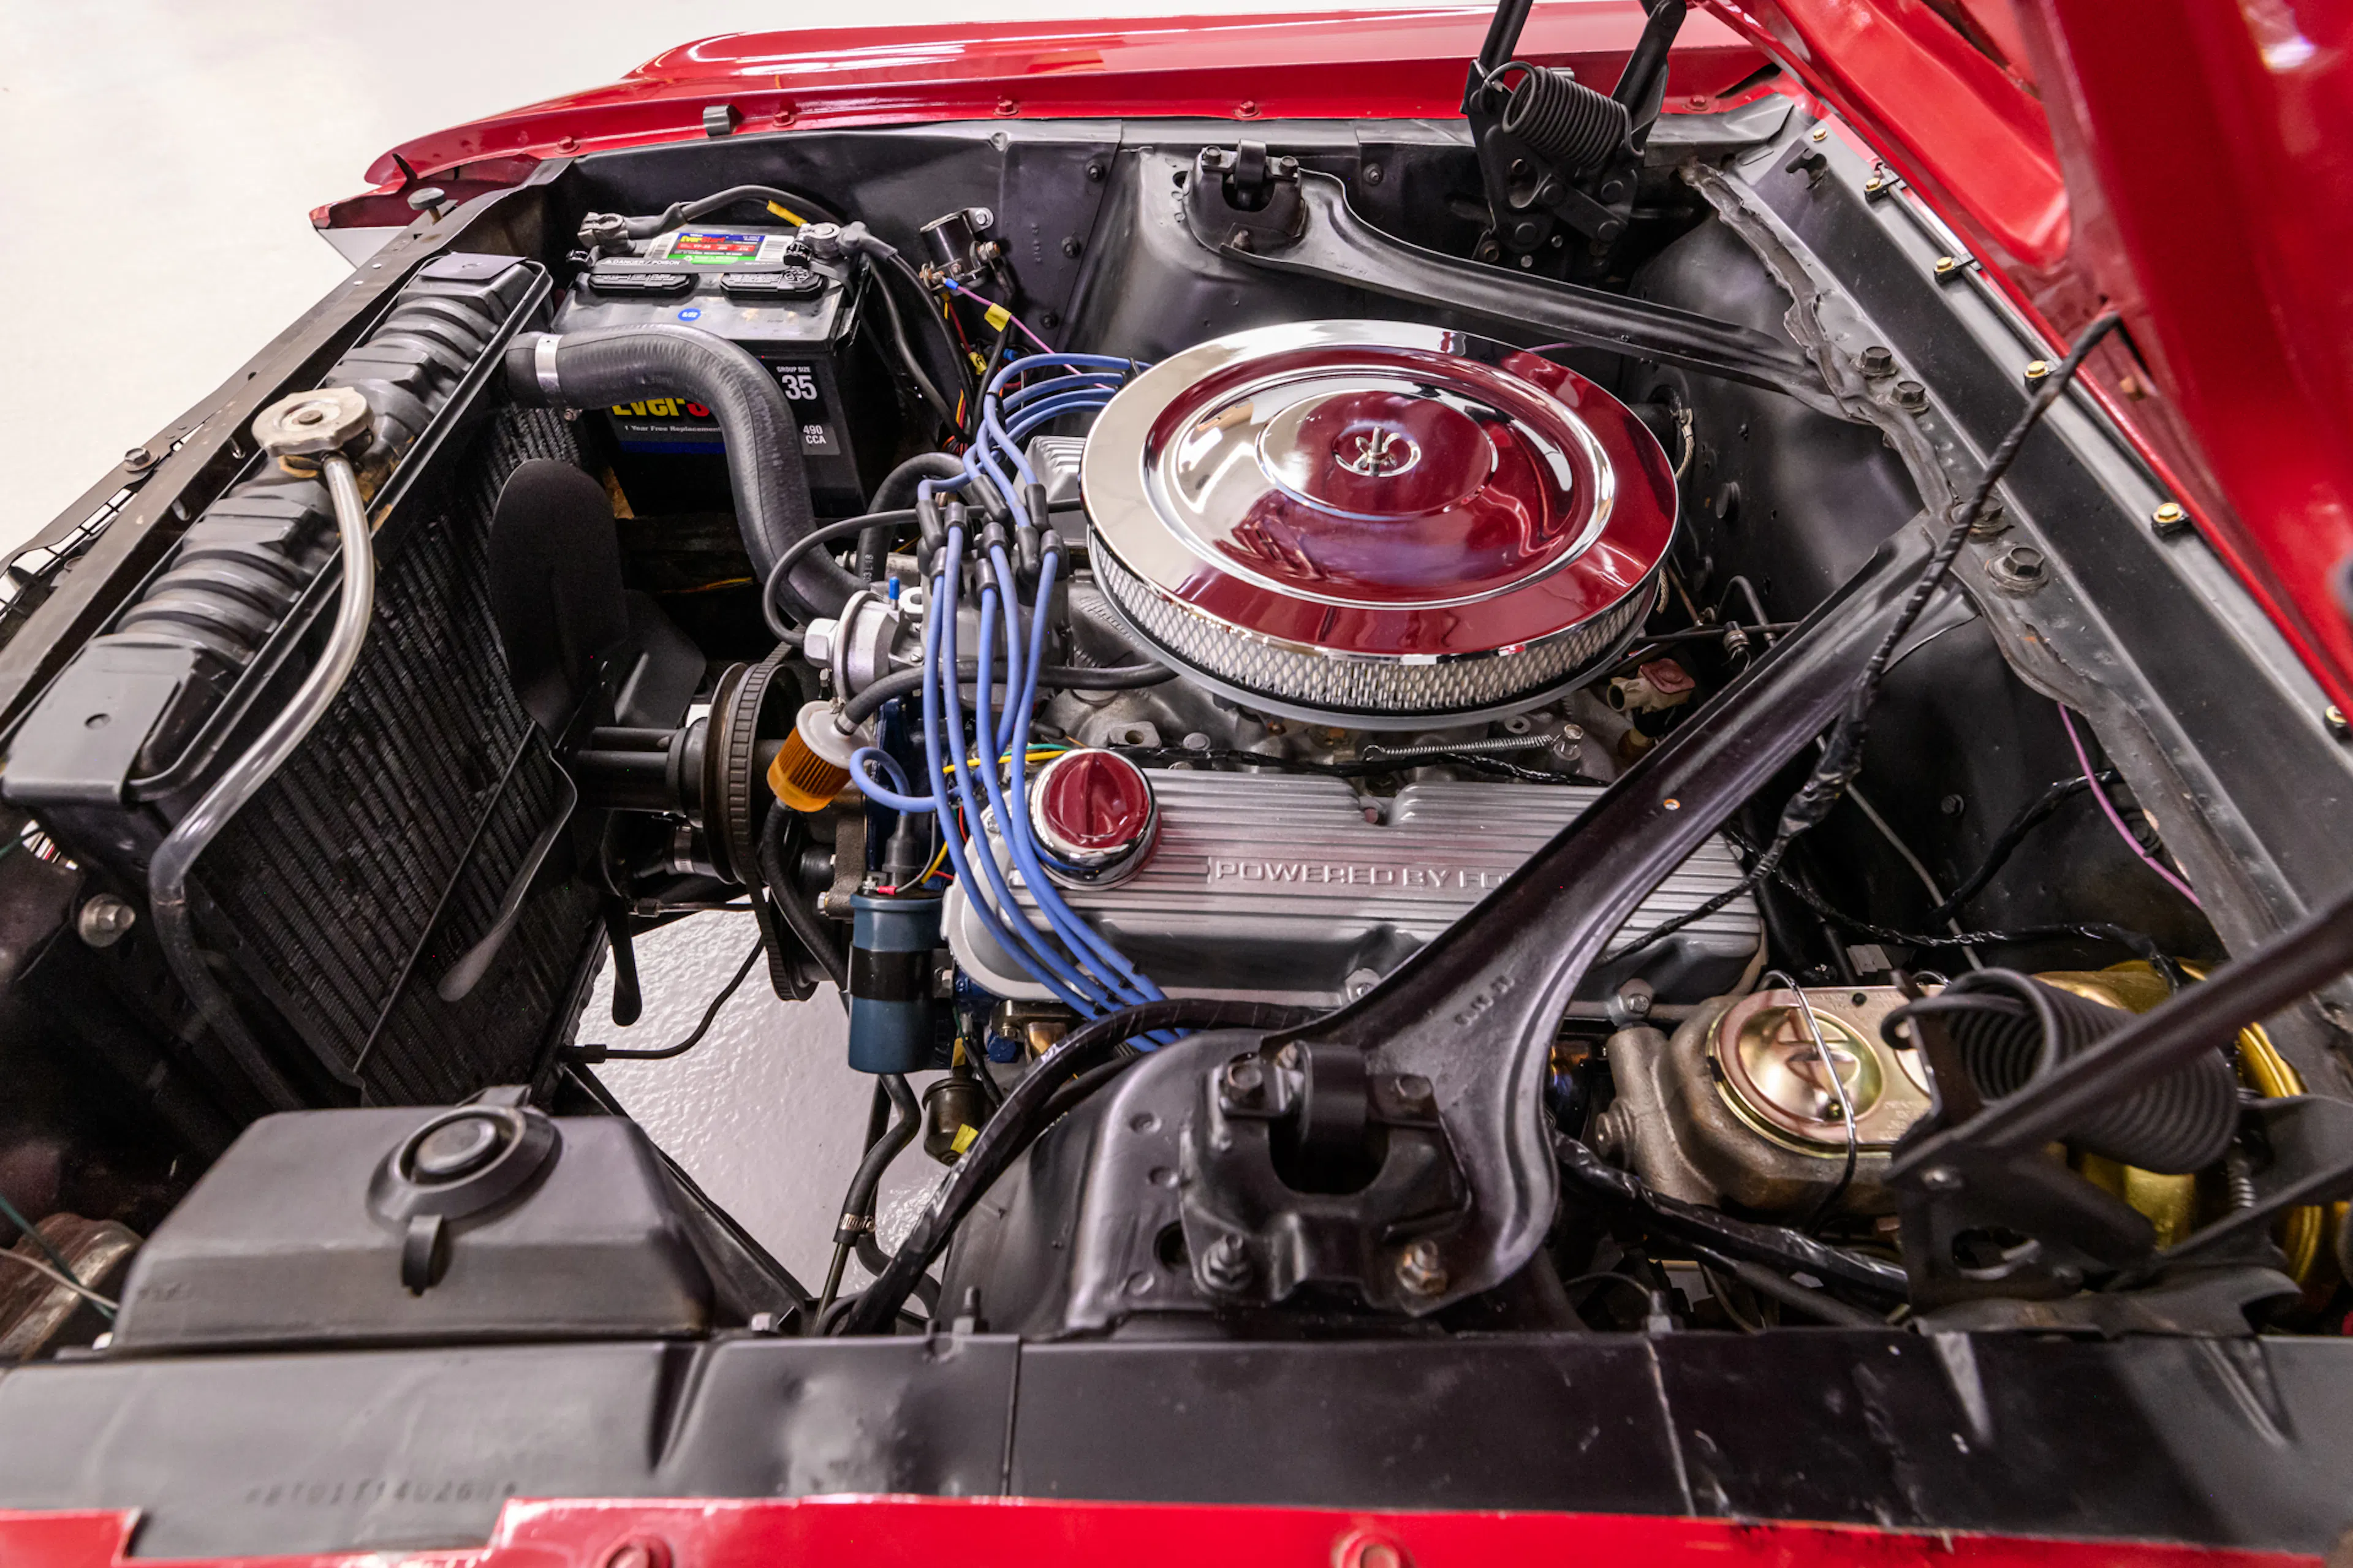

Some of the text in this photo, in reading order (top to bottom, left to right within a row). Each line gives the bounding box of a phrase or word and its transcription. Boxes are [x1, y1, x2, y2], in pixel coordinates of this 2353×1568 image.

[781, 374, 817, 400] 35
[803, 425, 823, 435] 490
[806, 435, 827, 444] CCA
[1216, 860, 1514, 890] POWERED BY FO
